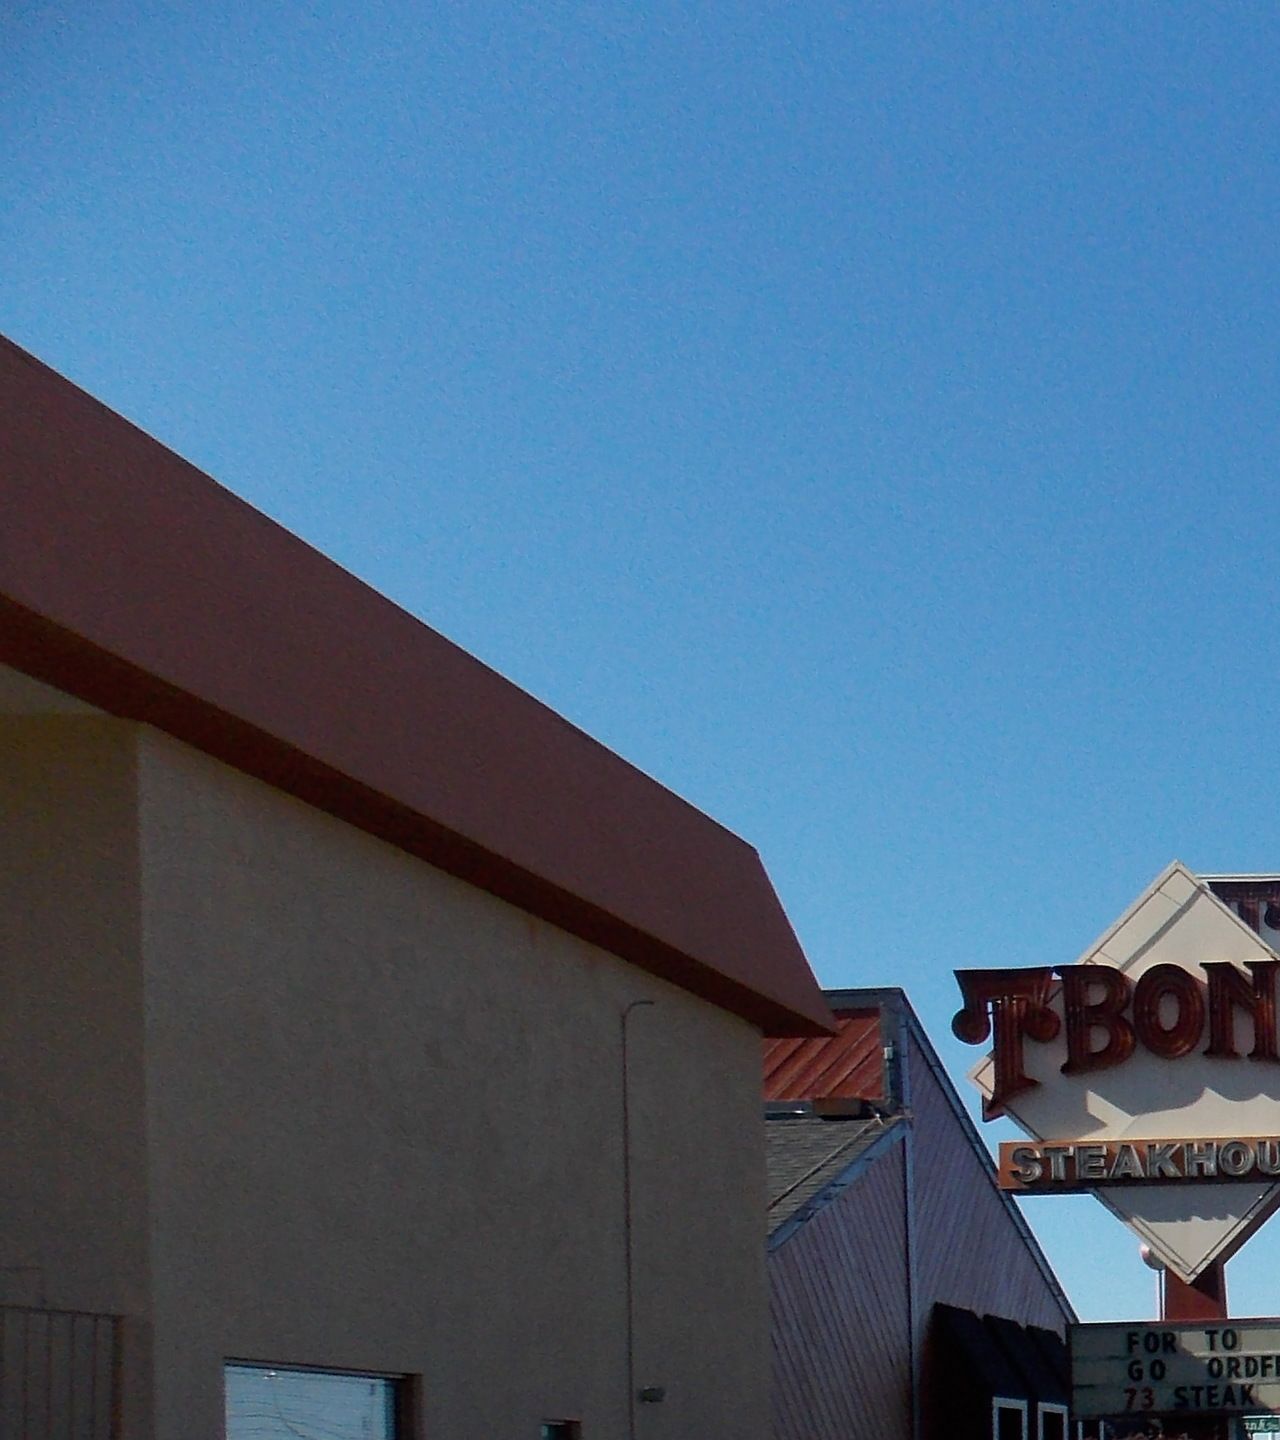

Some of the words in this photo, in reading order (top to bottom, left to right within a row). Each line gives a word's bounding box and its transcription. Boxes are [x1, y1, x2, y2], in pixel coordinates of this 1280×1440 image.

[1126, 1331, 1177, 1353] FOR
[1205, 1328, 1238, 1352] TO
[1127, 1358, 1167, 1382] GO
[1122, 1387, 1156, 1411] 73
[1174, 1384, 1256, 1408] STEAK
